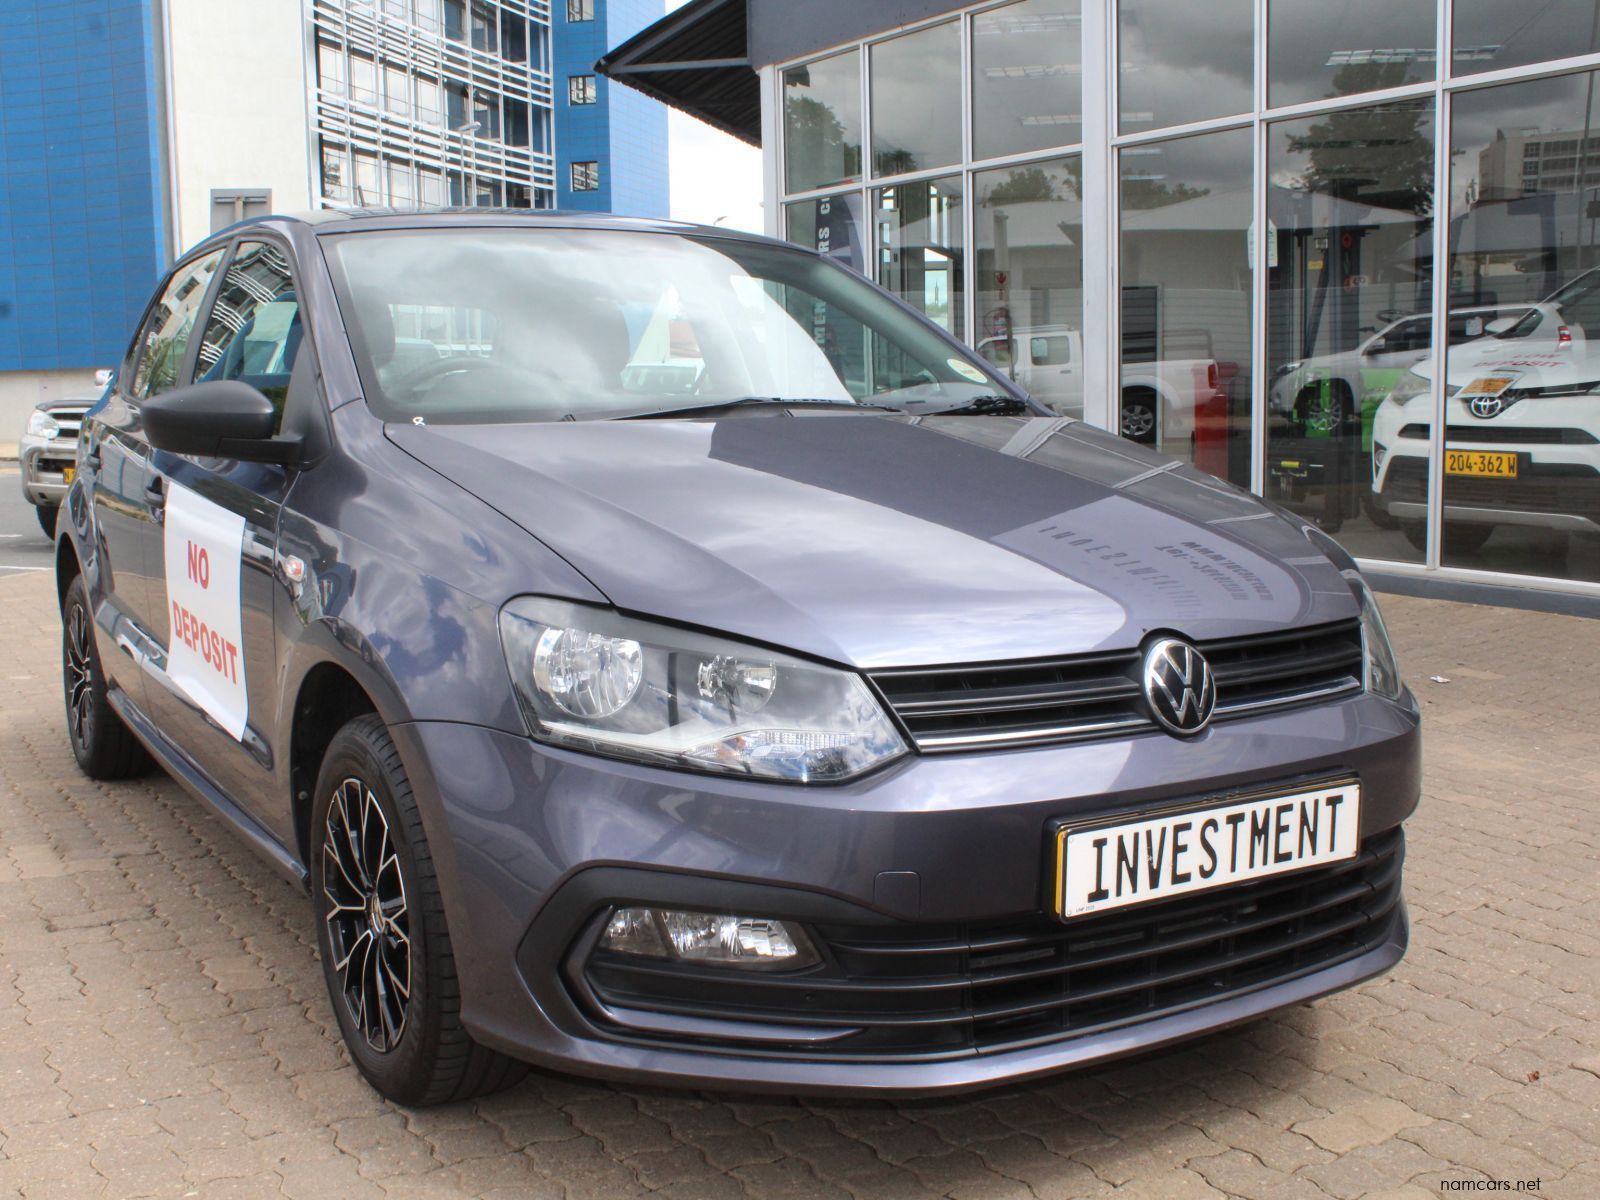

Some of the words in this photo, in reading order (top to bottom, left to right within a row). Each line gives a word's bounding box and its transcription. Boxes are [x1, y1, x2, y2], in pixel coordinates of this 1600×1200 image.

[1449, 454, 1504, 474] 204-362
[1508, 456, 1517, 475] W
[187, 540, 211, 590] NO
[172, 599, 238, 685] DEPOSIT
[1087, 794, 1344, 904] INVESTMENT
